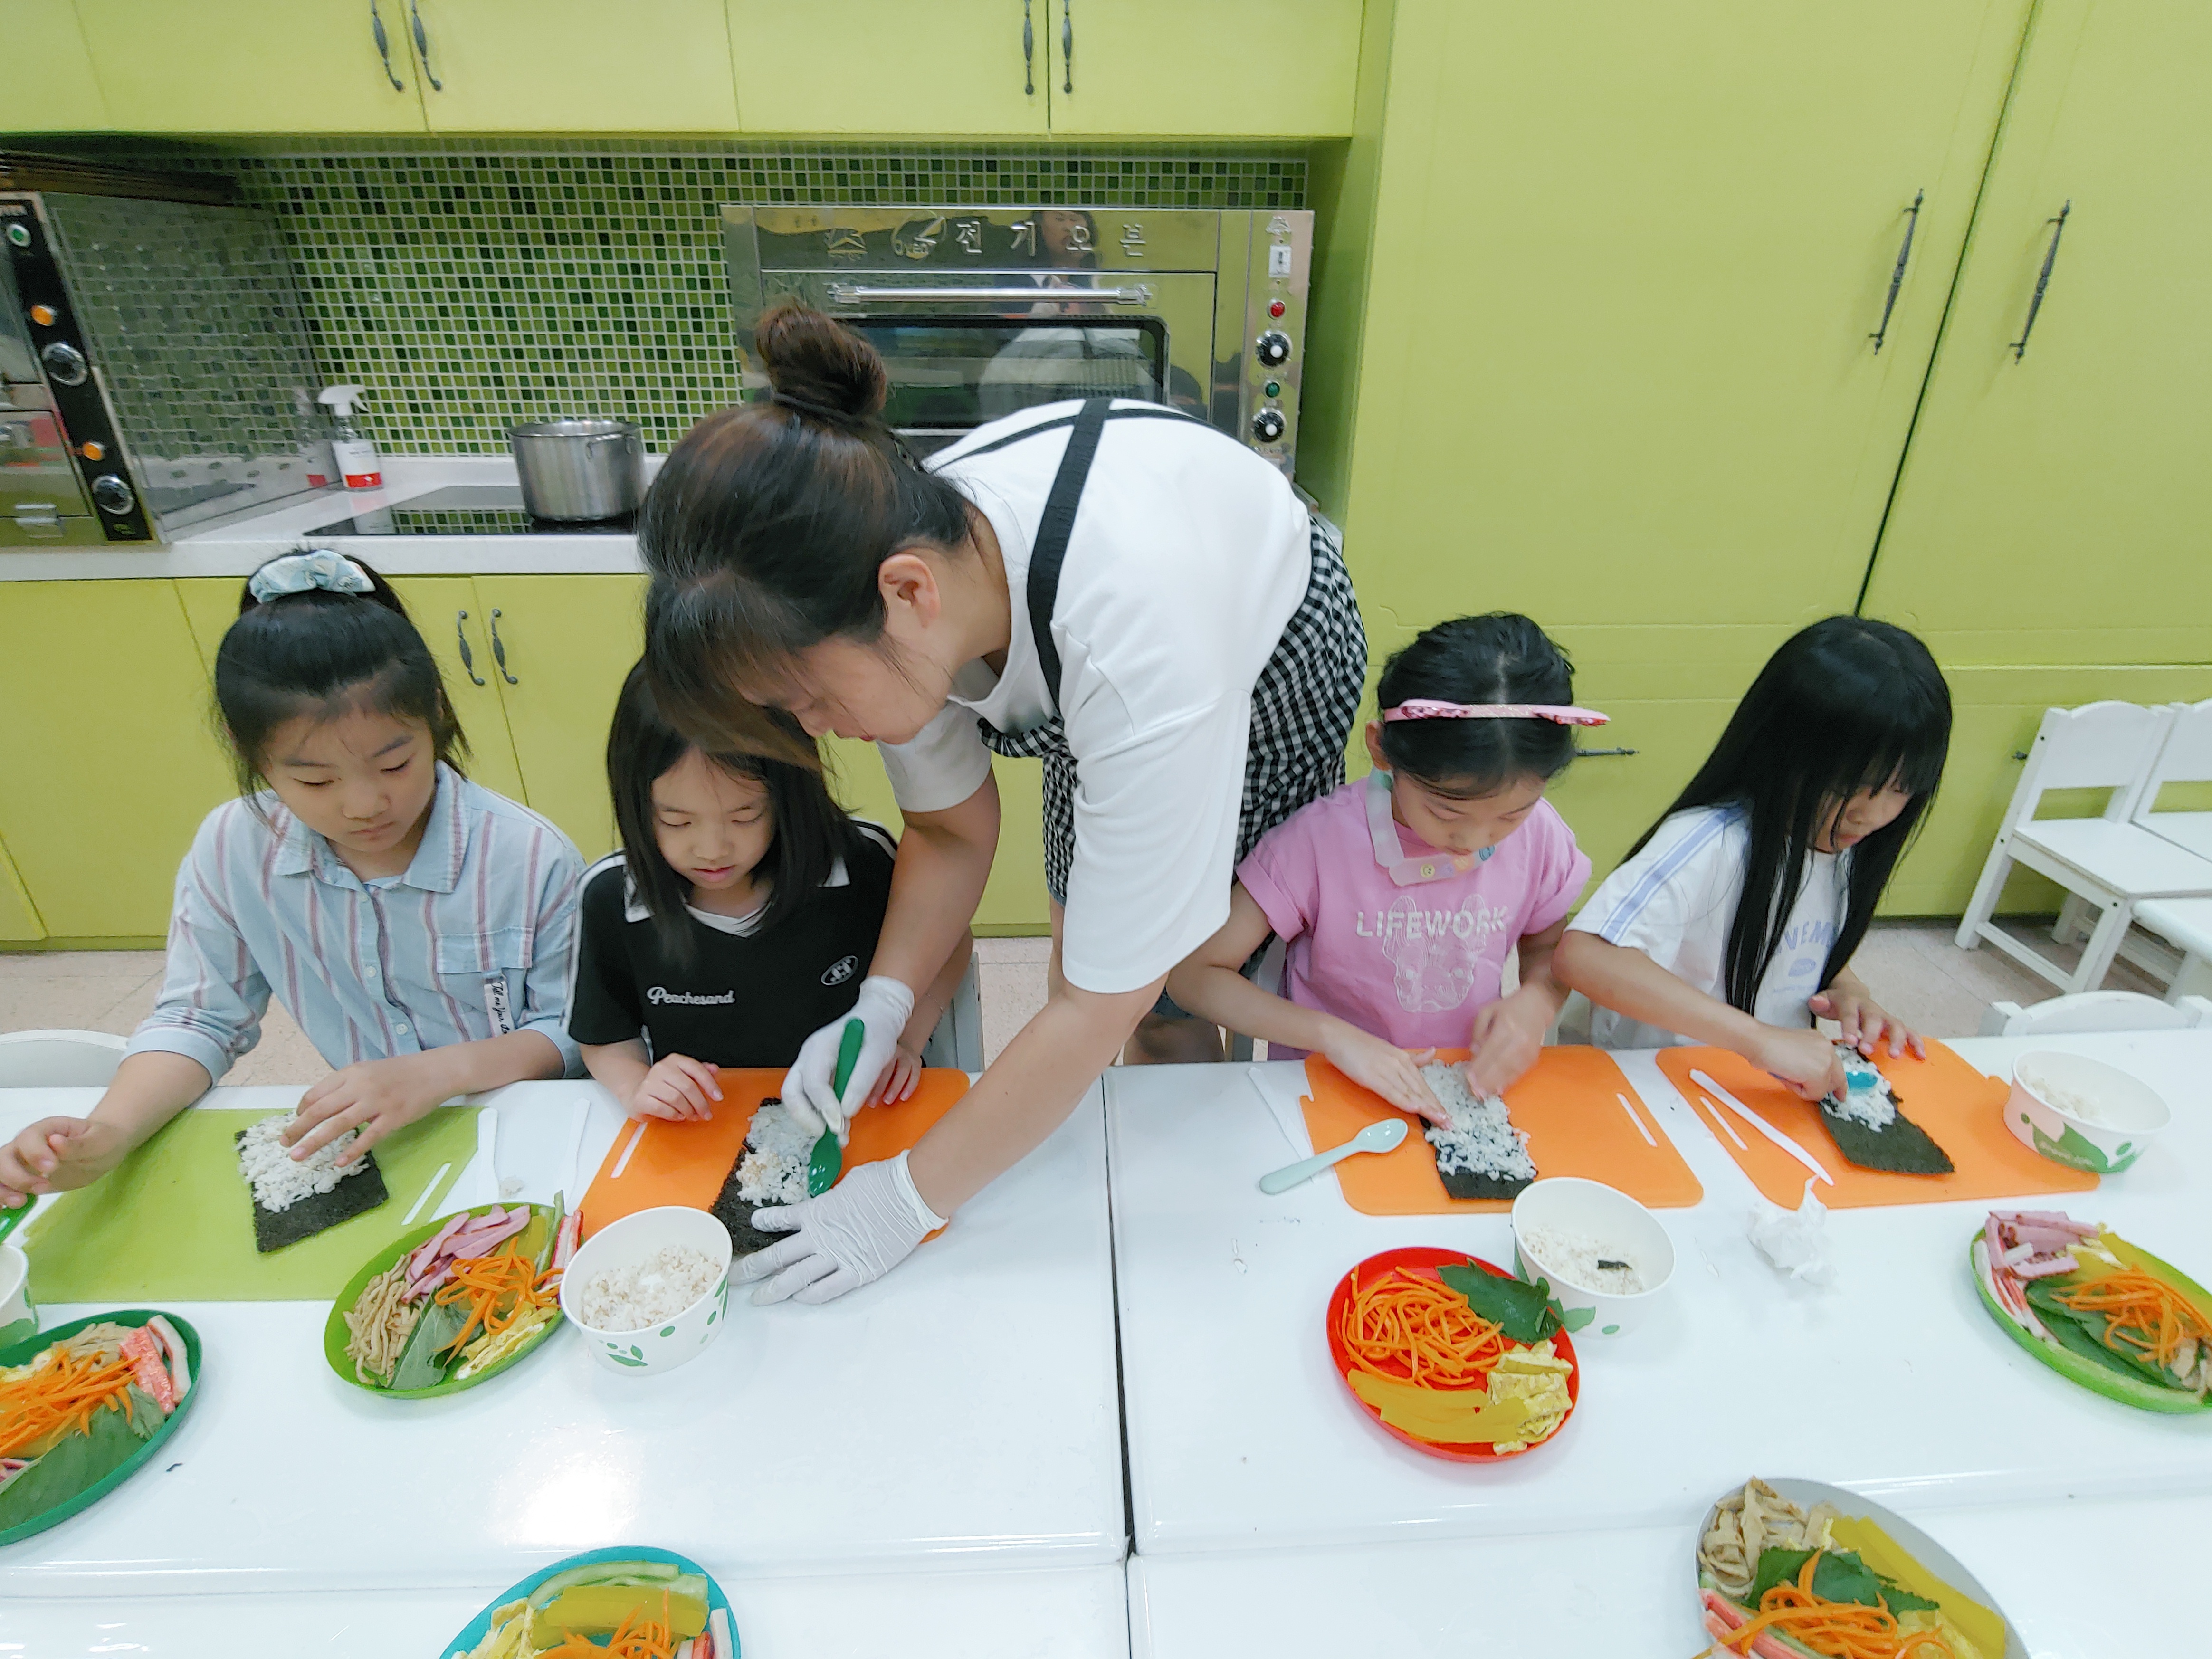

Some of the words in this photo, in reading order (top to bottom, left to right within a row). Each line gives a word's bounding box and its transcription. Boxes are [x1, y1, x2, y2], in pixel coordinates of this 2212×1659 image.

[1356, 905, 1508, 940] LIFEWORK
[492, 982, 504, 996] Tell
[647, 986, 735, 1005] Peachesand
[495, 997, 501, 1006] me
